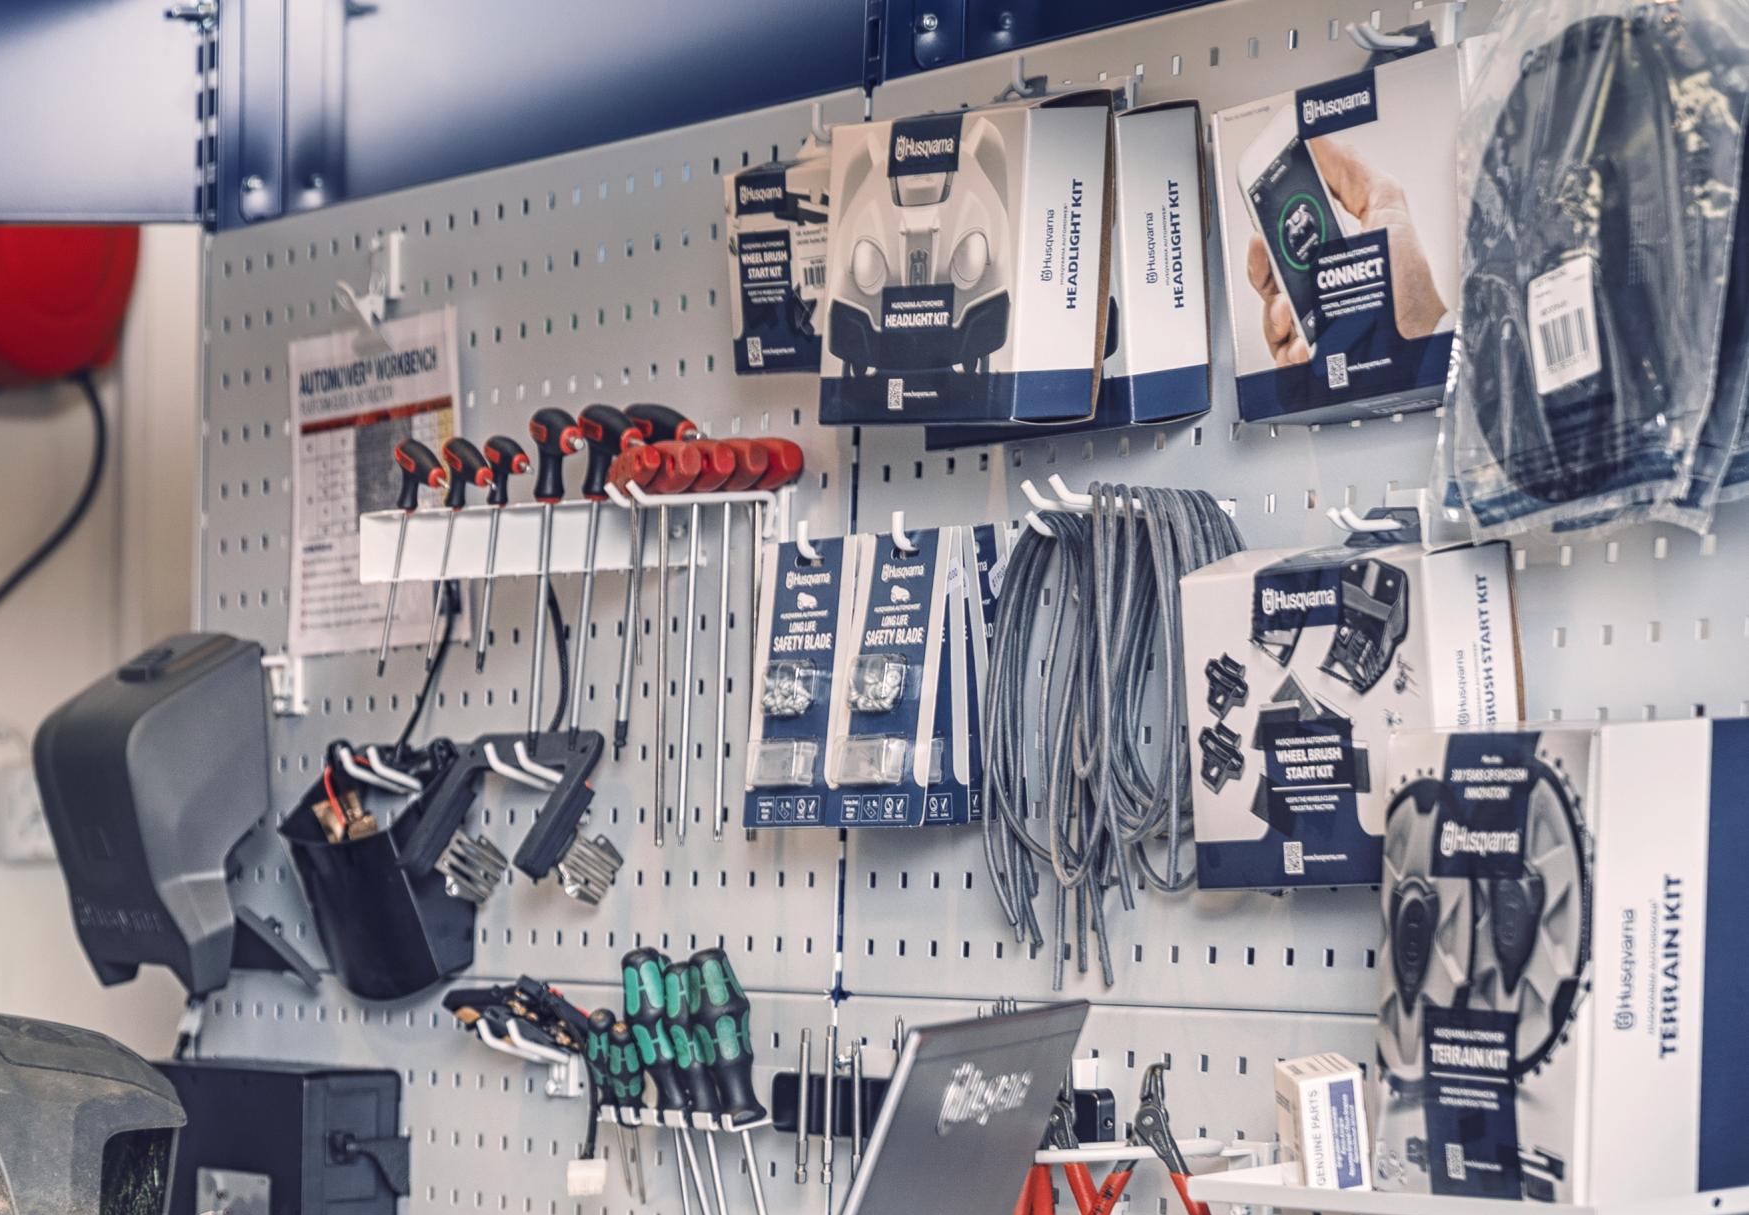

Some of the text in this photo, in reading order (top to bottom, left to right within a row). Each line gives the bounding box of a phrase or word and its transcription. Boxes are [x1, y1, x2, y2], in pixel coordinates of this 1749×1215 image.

[1313, 90, 1370, 118] Husqvarna
[904, 137, 955, 159] Husqvarna
[746, 186, 783, 202] Husqvarna
[1042, 209, 1055, 269] Husqvarna
[1066, 178, 1083, 309] HEADLIGHT KIT
[1146, 212, 1156, 271] Husqvarna
[1168, 180, 1184, 309] HEADLIGHT KIT
[741, 250, 788, 265] WHEEL BRUSH
[748, 265, 783, 279] START KIT
[1316, 257, 1385, 289] CONNECT
[885, 312, 950, 328] HEADLIGHT KIT
[375, 344, 437, 381] WORKBENCH
[793, 572, 831, 587] Husqvarna
[888, 565, 925, 580] Husqvarna
[1273, 589, 1336, 612] Husqvarna
[1475, 574, 1488, 604] KIT
[788, 620, 817, 633] LONG LIFE
[880, 614, 909, 627] LONG LIFE
[773, 632, 832, 652] SAFETY BLADE
[864, 627, 925, 647] SAFETY BLADE
[1478, 608, 1493, 664] START
[1275, 747, 1343, 763] WHEEL BRUSH
[1285, 765, 1335, 780] START KIT
[1455, 825, 1520, 857] Husqvarna
[1616, 908, 1636, 1009] Husqvarna
[1659, 874, 1683, 1061] TERRAIN KIT
[1430, 1043, 1510, 1071] TERRAIN KIT
[1308, 1089, 1326, 1186] GENUINE PARTS
